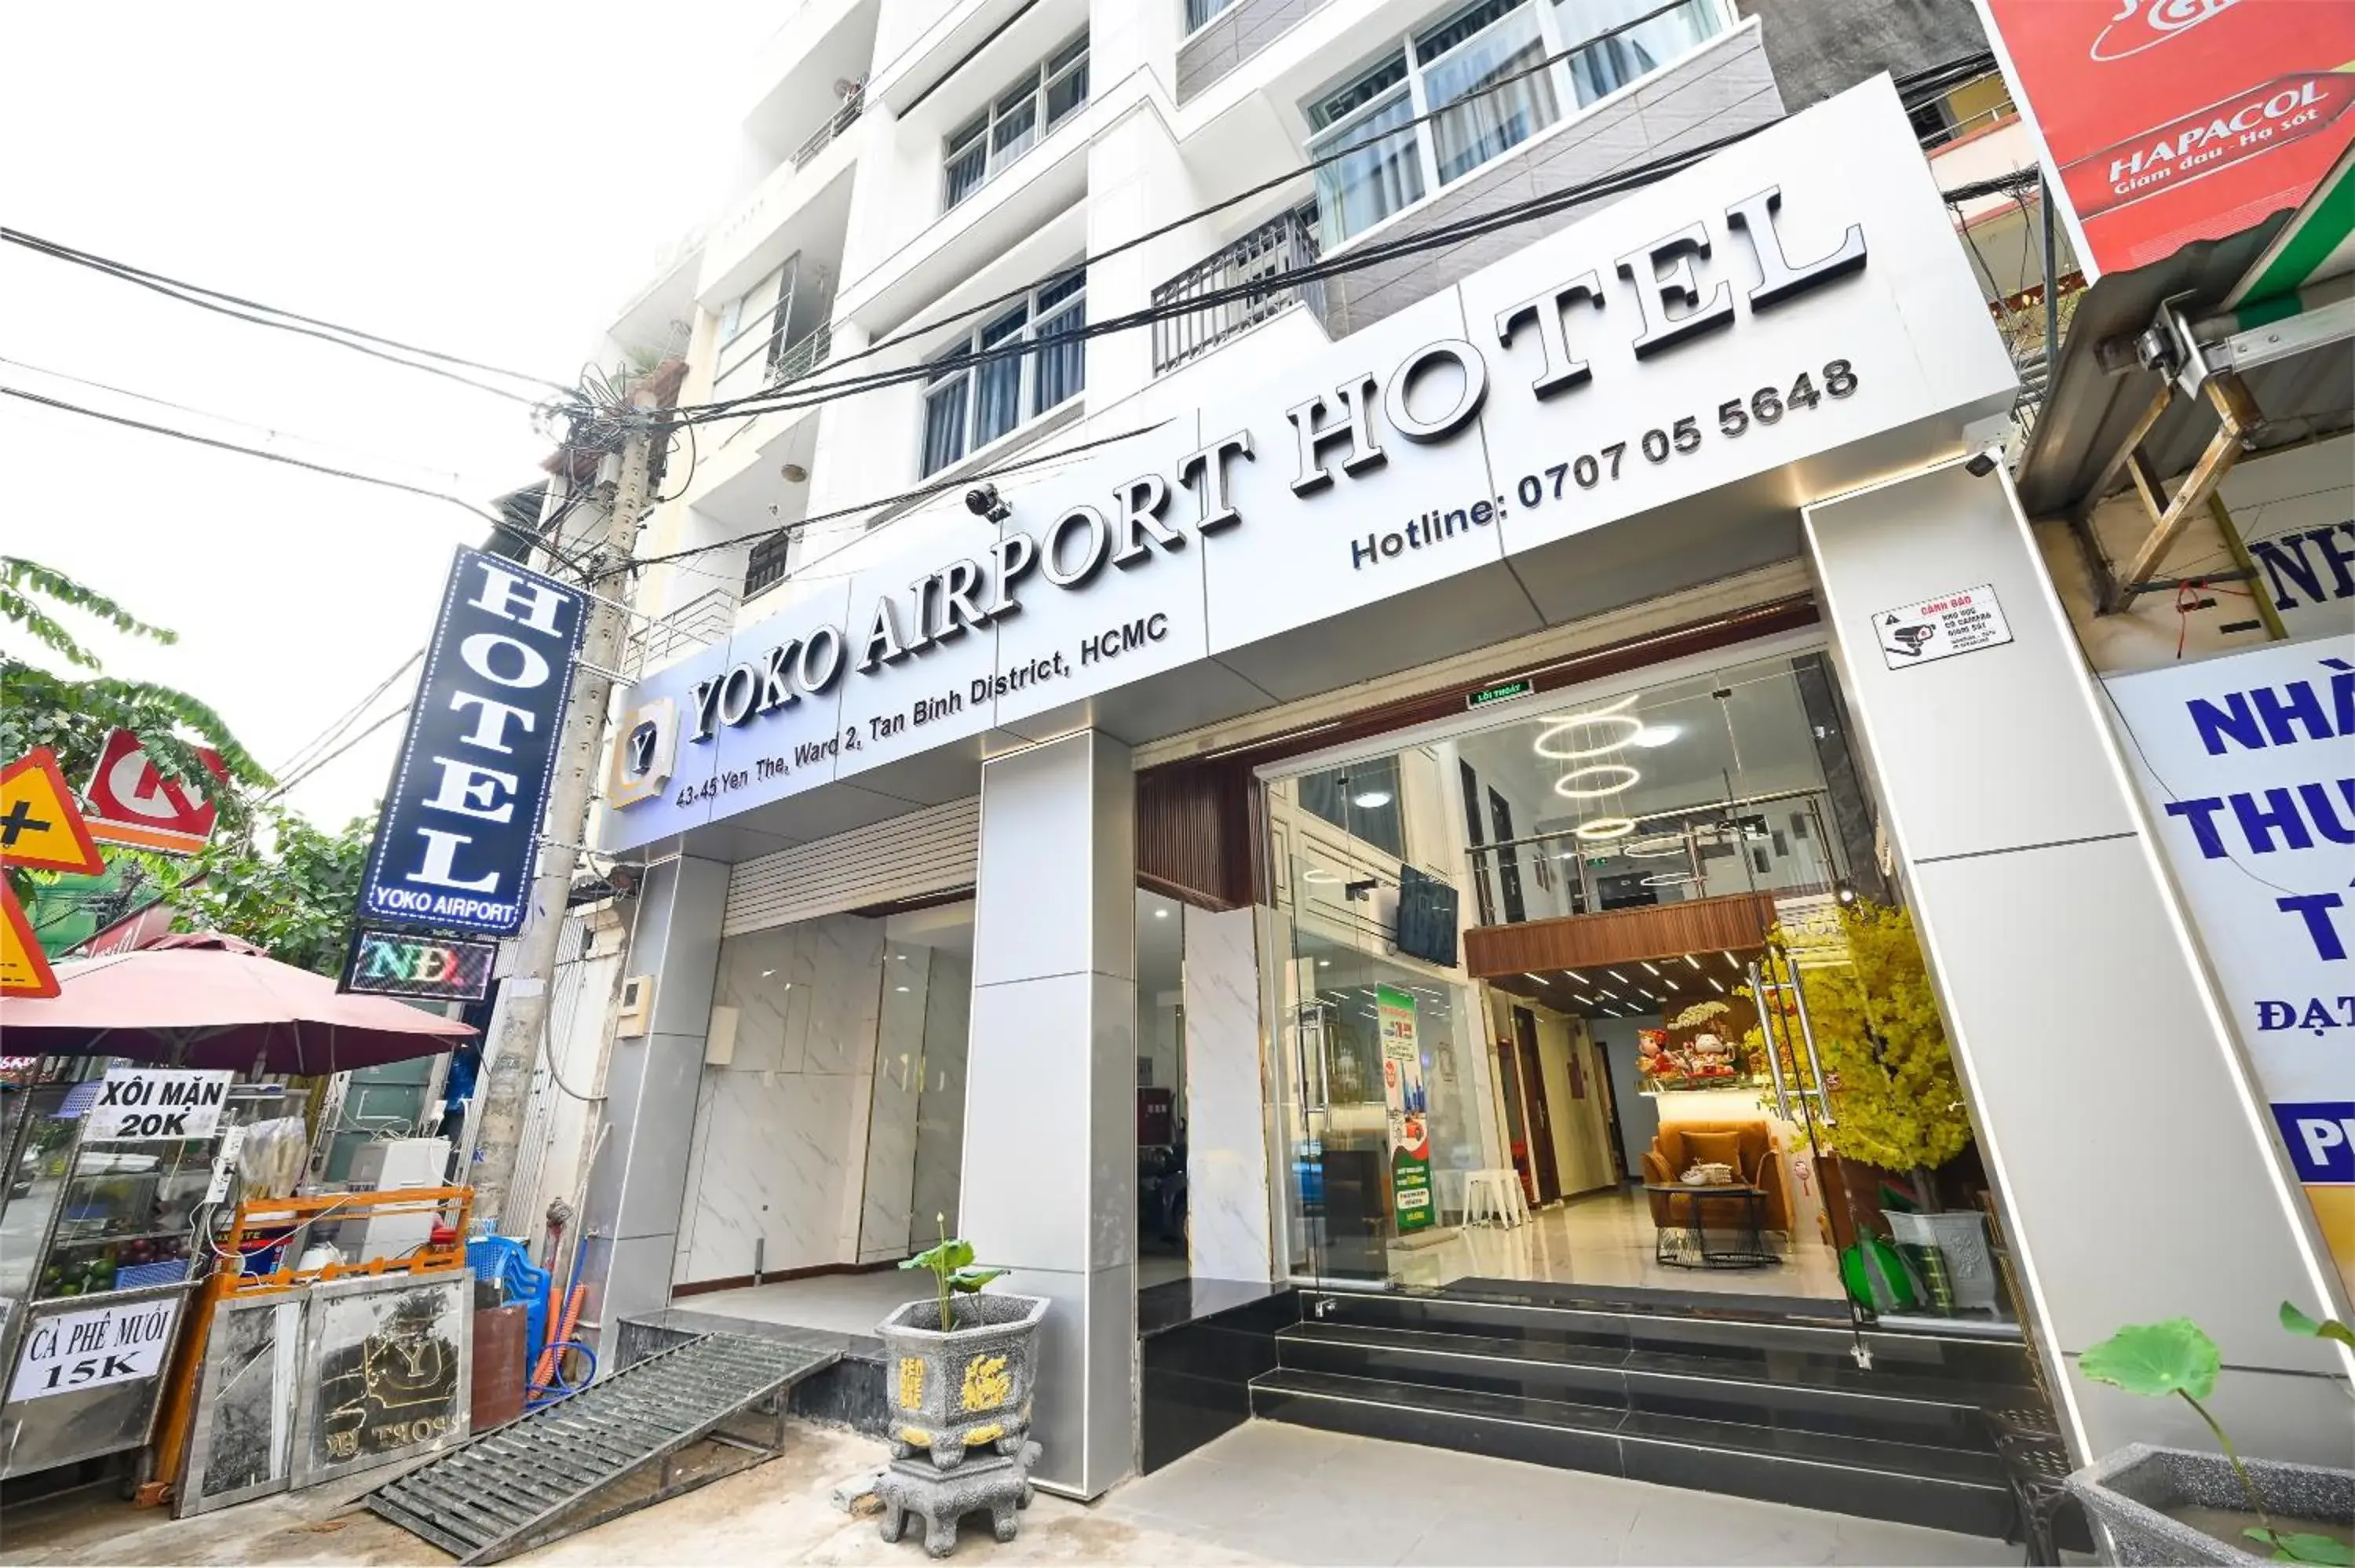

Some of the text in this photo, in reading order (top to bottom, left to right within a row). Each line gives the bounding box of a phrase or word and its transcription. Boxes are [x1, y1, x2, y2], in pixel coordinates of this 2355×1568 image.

[2110, 82, 2329, 182] HAPACOL
[688, 184, 1868, 745] YOKO AIRPORT HOTEL
[1350, 359, 1860, 570] Hotline: 0707 05 5648
[406, 562, 570, 895] HOTEL
[721, 770, 748, 794] Yen
[794, 730, 839, 768] Ward
[869, 713, 906, 742] Tan
[912, 688, 964, 726] Binh
[970, 650, 1072, 706] District,
[1080, 612, 1170, 666] HCMC
[377, 886, 515, 923] YOKO AIRPORT
[99, 1074, 224, 1112] XÔI MẶN
[115, 1112, 191, 1137] 20K
[2296, 1118, 2355, 1166] P
[30, 1318, 61, 1361] CÀ
[65, 1310, 111, 1355] PHÊ
[40, 1351, 142, 1390] 15K
